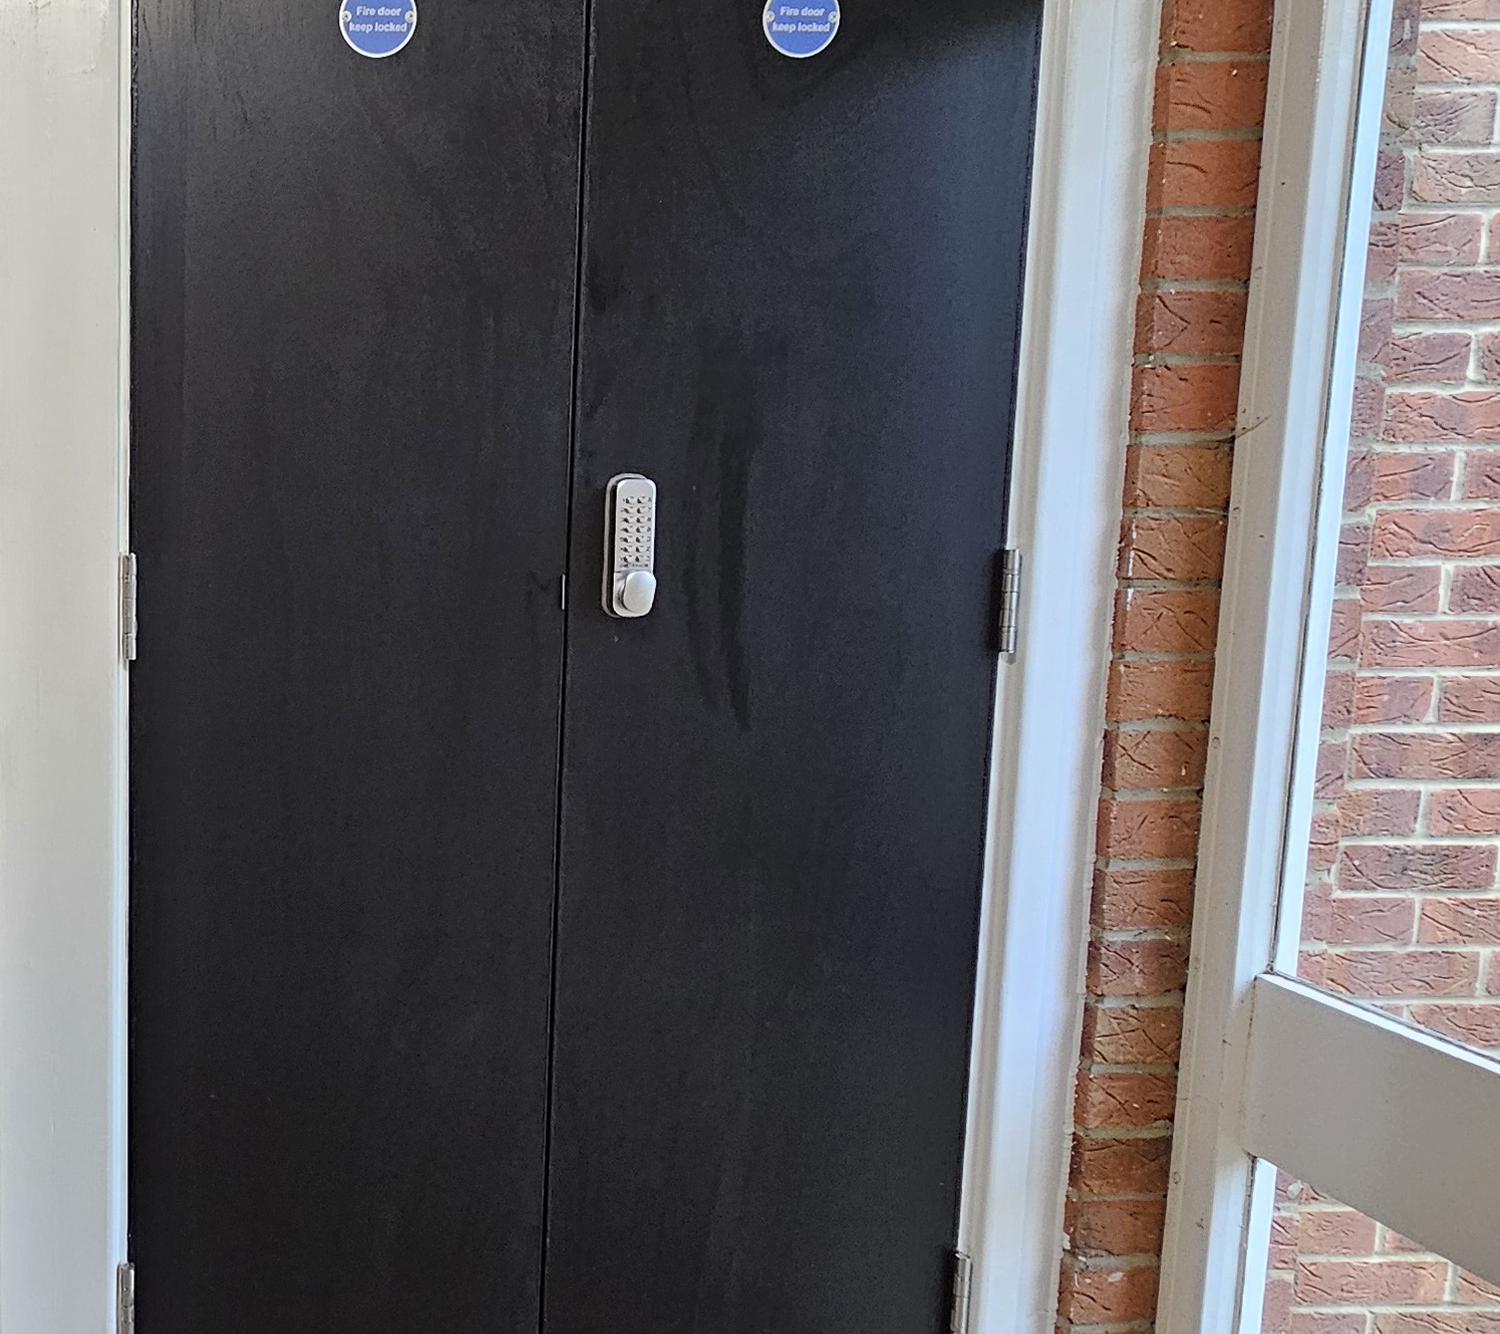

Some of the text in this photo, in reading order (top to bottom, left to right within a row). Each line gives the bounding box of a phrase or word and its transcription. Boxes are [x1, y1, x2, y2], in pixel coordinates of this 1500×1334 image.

[356, 5, 402, 17] Fire door
[779, 5, 825, 17] Fire door
[348, 21, 408, 34] keep locked
[772, 21, 831, 34] keep locked
